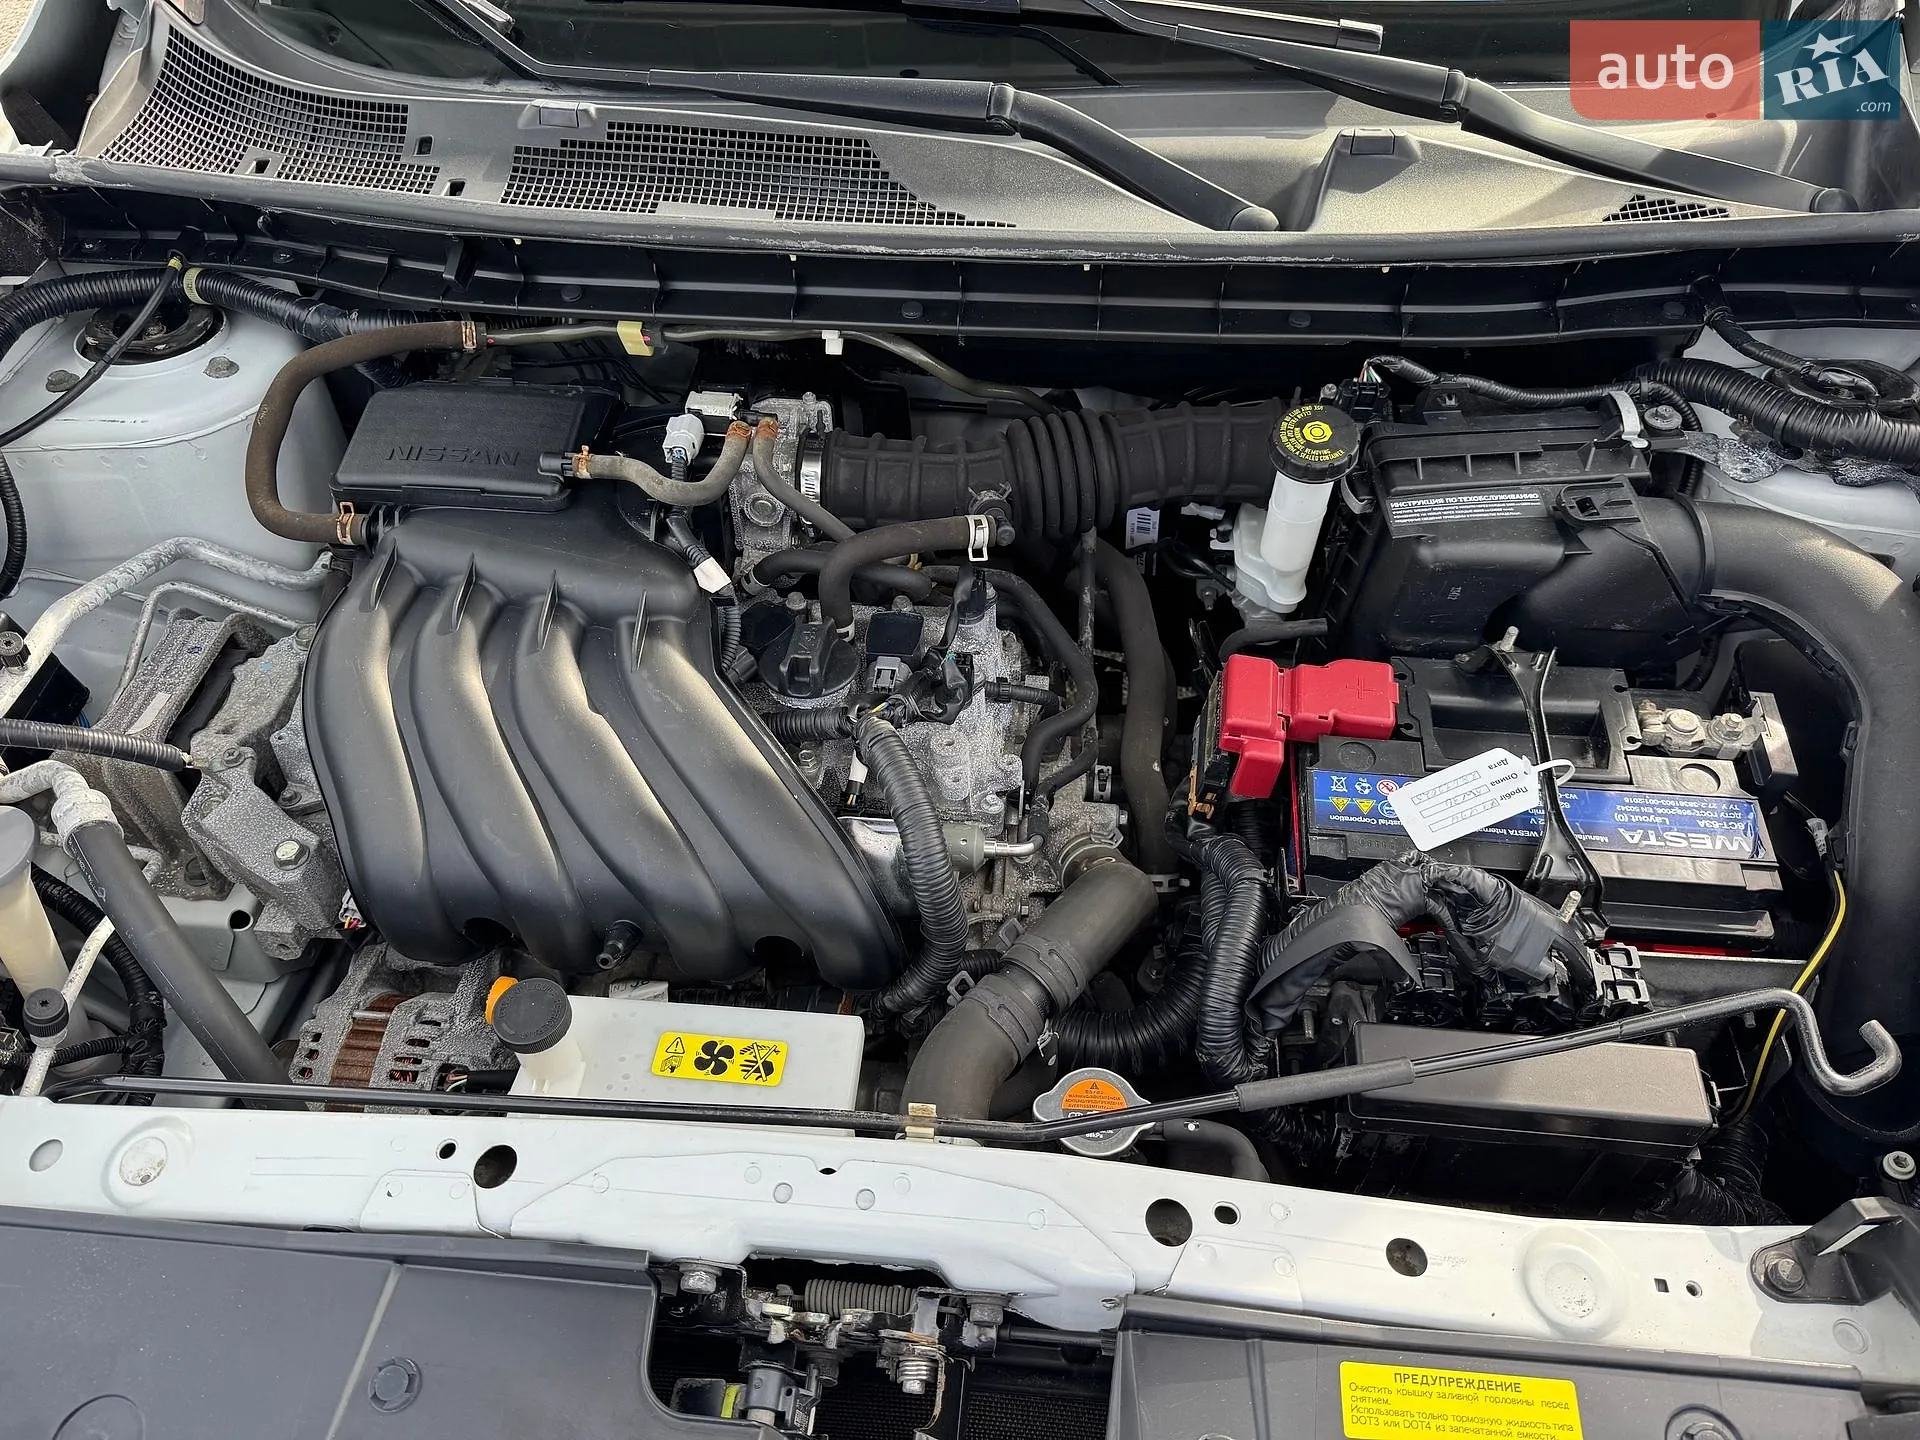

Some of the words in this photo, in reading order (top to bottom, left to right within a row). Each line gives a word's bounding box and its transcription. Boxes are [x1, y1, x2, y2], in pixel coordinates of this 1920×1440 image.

[386, 445, 520, 466] NISSAN
[1390, 498, 1444, 508] ИНСТРУКЦИЯ
[1445, 496, 1458, 504] ПО
[1458, 493, 1540, 502] ТЕХОБСЛУЖИВАНИЮ
[1488, 758, 1509, 770] Дата
[1500, 786, 1529, 801] Пробіг
[1329, 814, 1377, 825] Corporation
[1378, 818, 1403, 826] ustrial
[1630, 814, 1670, 825] Layout
[1508, 829, 1540, 838] WESTA
[1618, 828, 1752, 852] WESTA
[1394, 1372, 1522, 1393] ПРЕДУПРЕЖДЕНИЕ
[1349, 1382, 1393, 1395] Очистить
[1396, 1388, 1433, 1399] крышку
[1436, 1391, 1479, 1402] заливной
[1484, 1395, 1535, 1407] горловины
[1541, 1400, 1570, 1410] перед
[1350, 1395, 1392, 1405] снятием.
[1350, 1404, 1414, 1418] Использовать
[1417, 1411, 1448, 1422] только
[1452, 1414, 1502, 1426] тормозную
[1506, 1419, 1551, 1430] жидкость
[1553, 1423, 1574, 1431] типа
[1351, 1415, 1380, 1426] DOT3
[1383, 1420, 1400, 1428] или
[1404, 1419, 1432, 1430] DOT4
[1436, 1424, 1446, 1433] из
[1449, 1426, 1513, 1438] запечатанной
